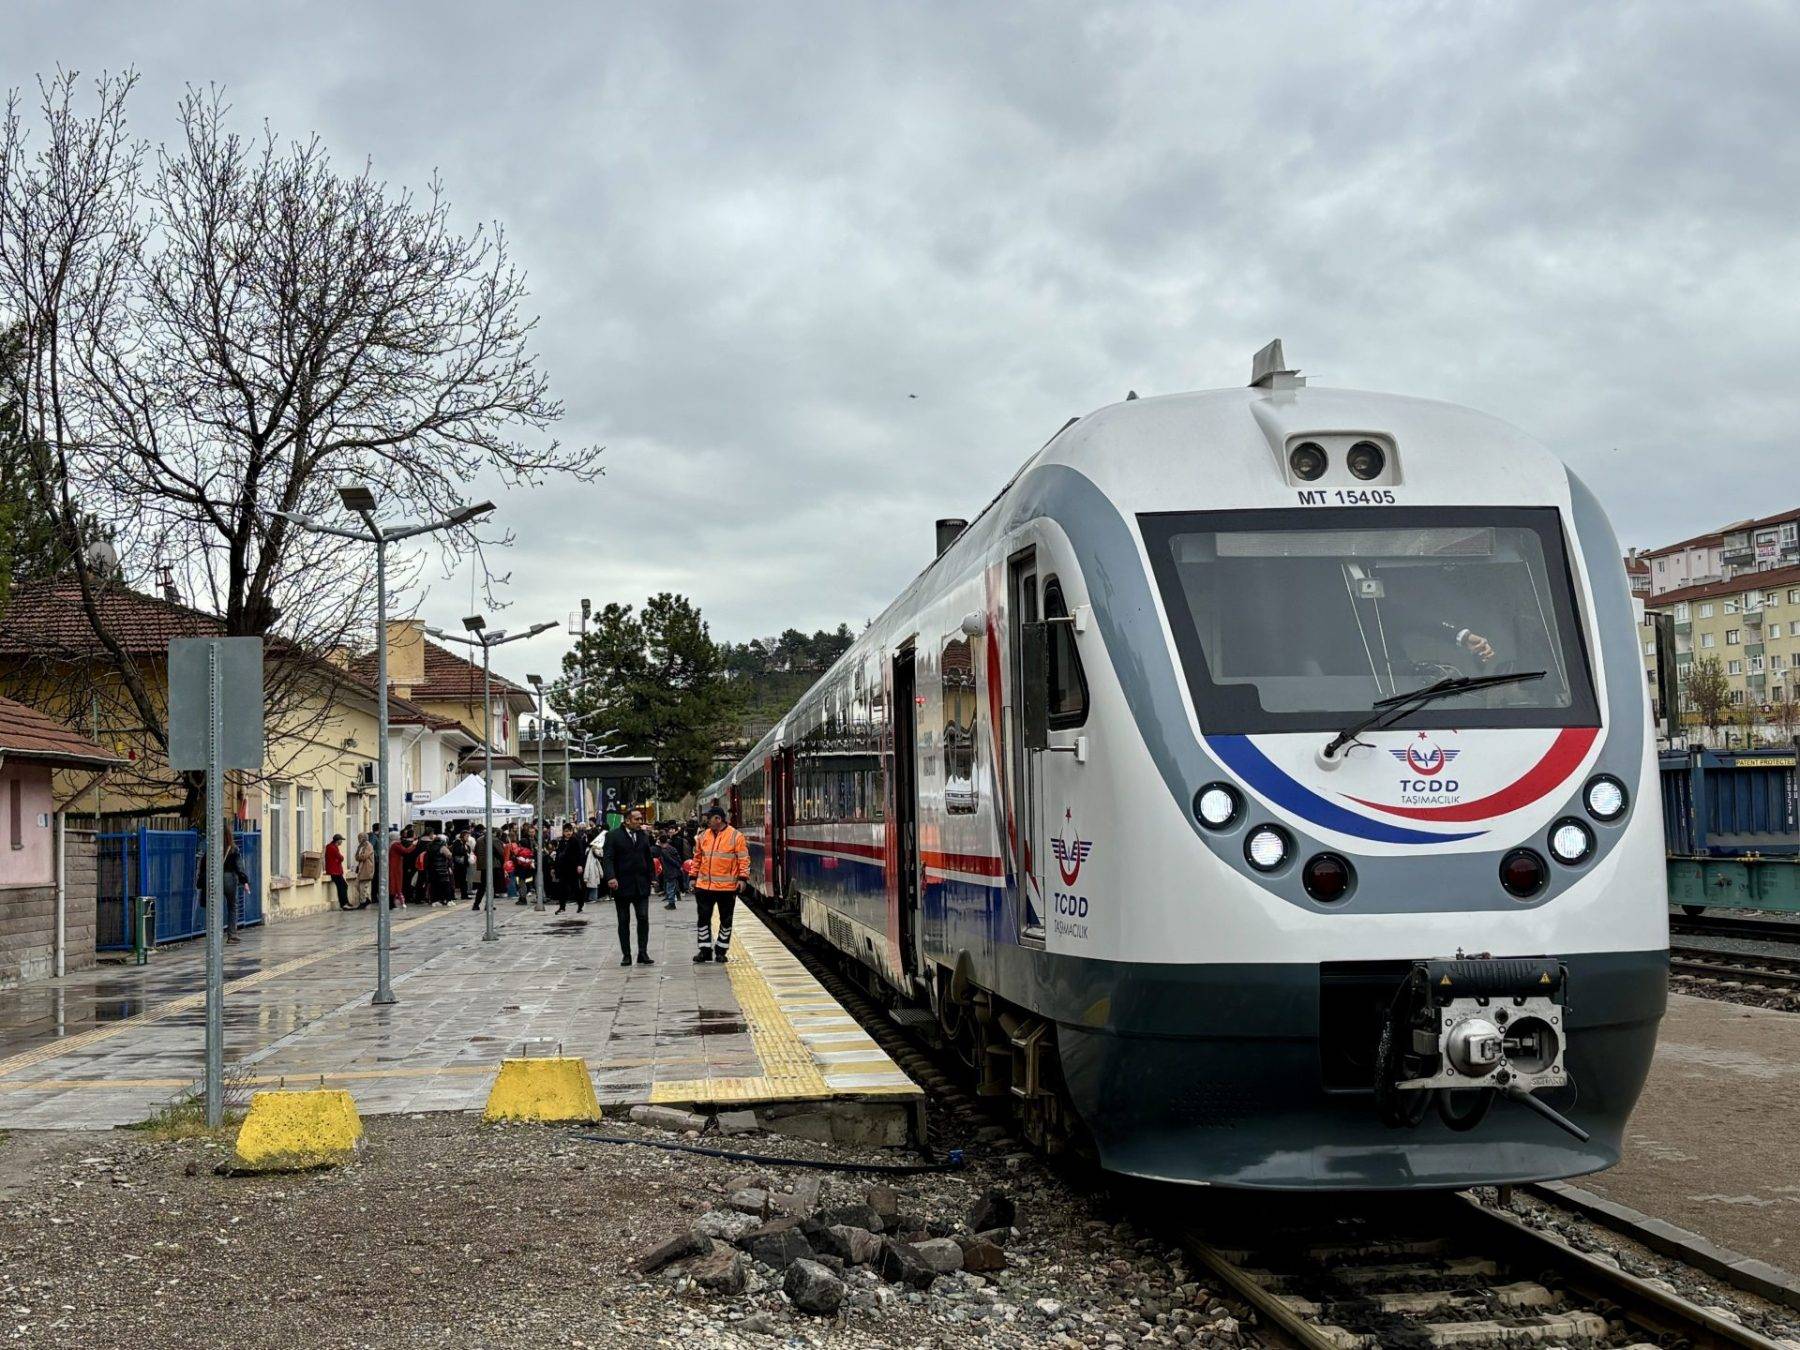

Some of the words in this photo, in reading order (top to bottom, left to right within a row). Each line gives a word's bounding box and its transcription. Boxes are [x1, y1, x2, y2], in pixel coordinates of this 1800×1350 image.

[1297, 490, 1327, 505] MT
[1335, 490, 1395, 504] 15405
[1400, 780, 1459, 792] TCDD
[1401, 795, 1460, 804] TAŞIMACILIK
[1054, 892, 1089, 918] TCDD
